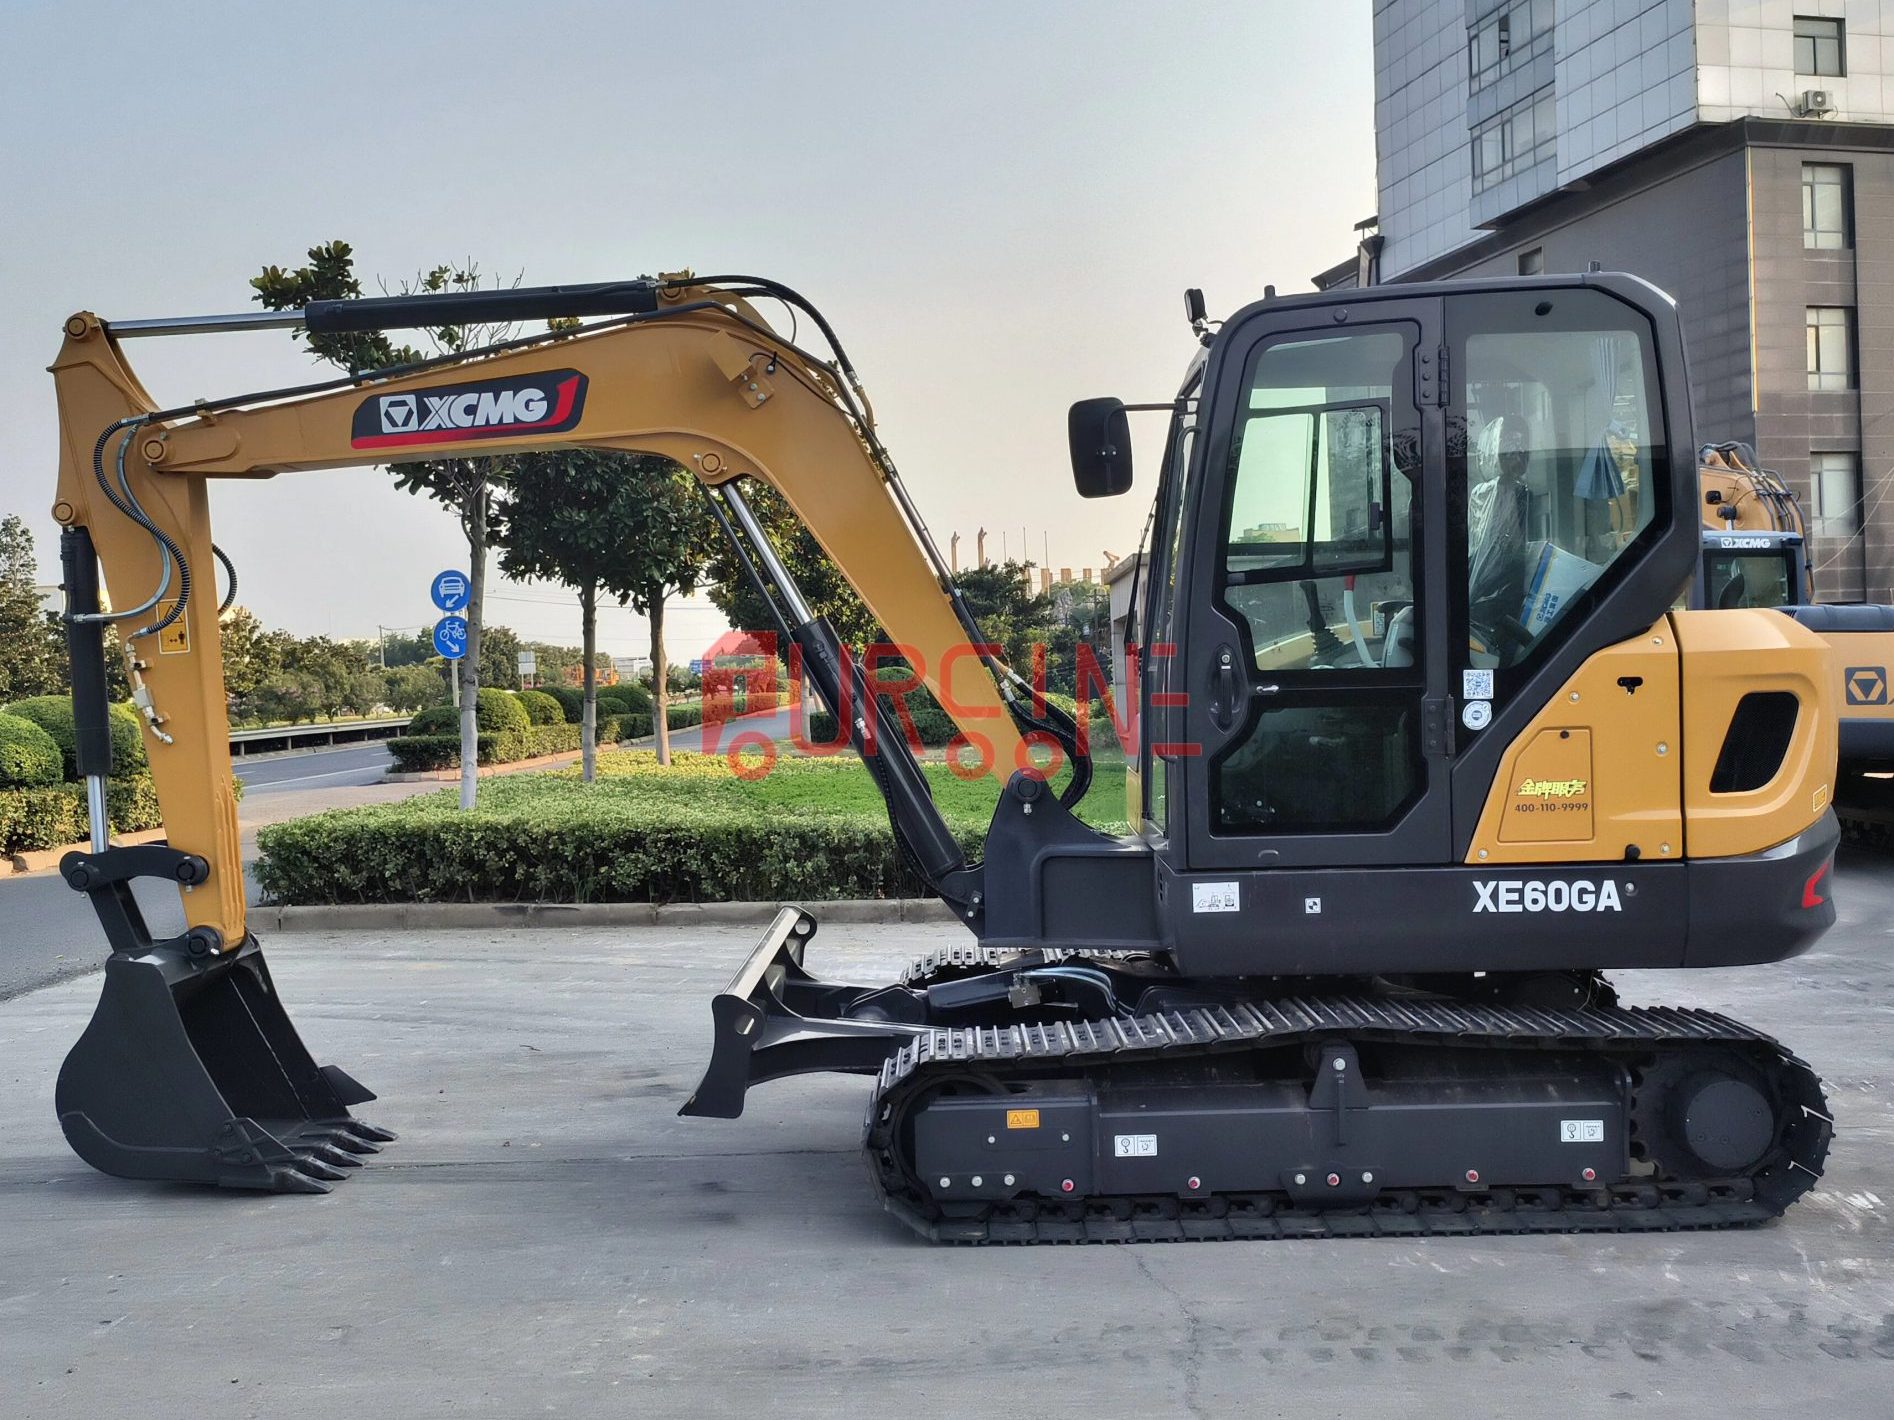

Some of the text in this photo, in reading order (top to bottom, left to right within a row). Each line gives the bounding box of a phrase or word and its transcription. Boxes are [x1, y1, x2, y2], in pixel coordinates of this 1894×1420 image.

[418, 388, 548, 431] XCMG
[1733, 538, 1771, 548] XCMG
[1515, 803, 1588, 812] 400-110-9999
[1472, 880, 1622, 913] XE60GA
